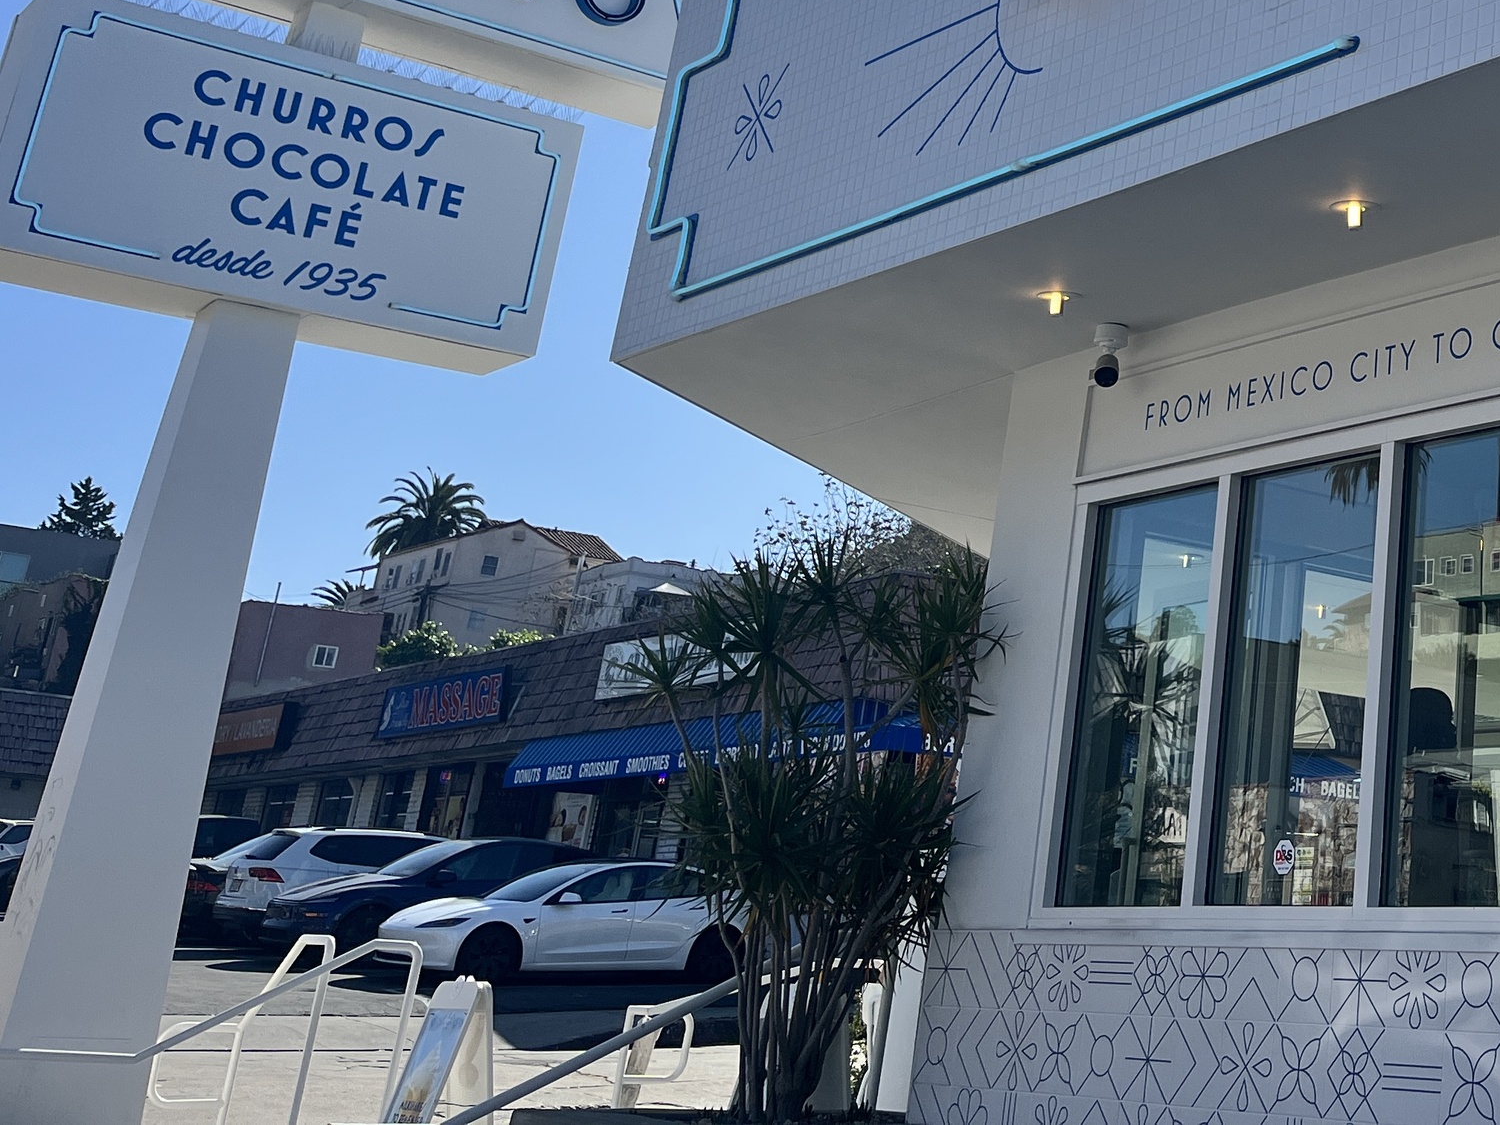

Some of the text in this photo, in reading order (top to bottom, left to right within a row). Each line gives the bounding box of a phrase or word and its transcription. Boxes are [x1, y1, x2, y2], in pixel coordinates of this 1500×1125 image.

[193, 69, 445, 157] CHURROS
[144, 112, 465, 219] CHOCOLATE
[230, 189, 362, 248] CAFÉ
[172, 238, 387, 301] desde 1935
[1145, 389, 1211, 431] FROM
[1227, 360, 1334, 413] MEXICO
[1350, 339, 1416, 383] CITY
[1432, 327, 1473, 364] TO
[407, 673, 503, 730] MASSAGE
[513, 767, 542, 784] DONUTS
[545, 764, 573, 781] BAGELS
[578, 759, 620, 778] CROISSANT
[625, 754, 671, 774] SMOOTHIES
